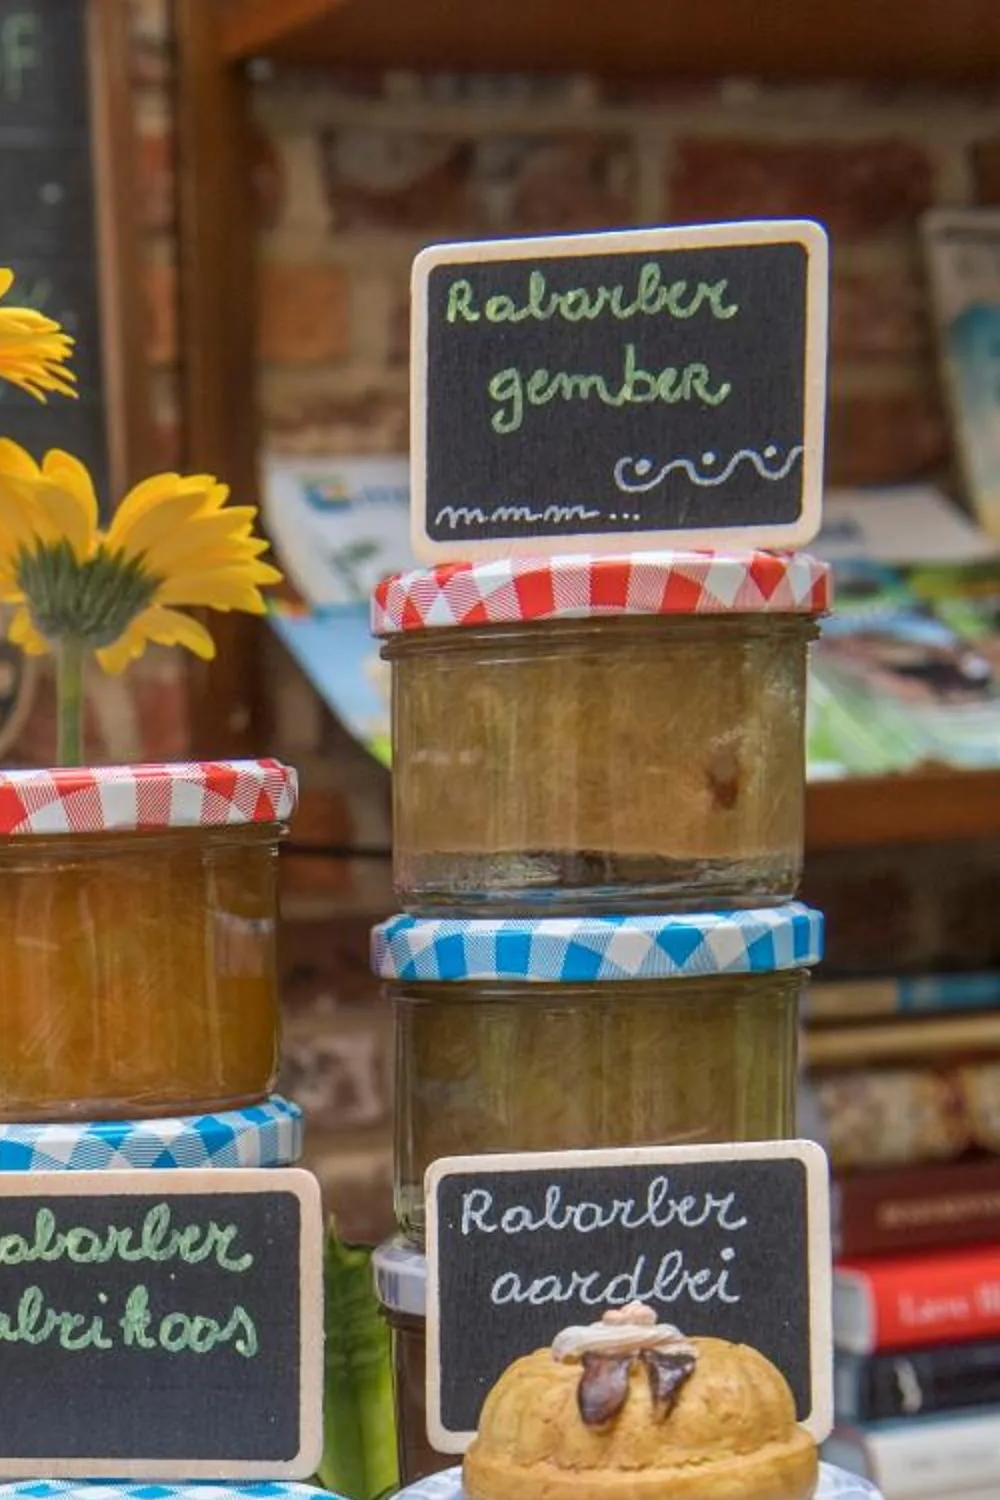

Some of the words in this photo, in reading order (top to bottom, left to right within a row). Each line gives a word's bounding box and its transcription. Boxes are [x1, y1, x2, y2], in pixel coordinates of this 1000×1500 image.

[446, 262, 739, 323] Rabarber
[461, 1175, 748, 1235] Rabarber
[490, 1247, 740, 1304] aardbei
